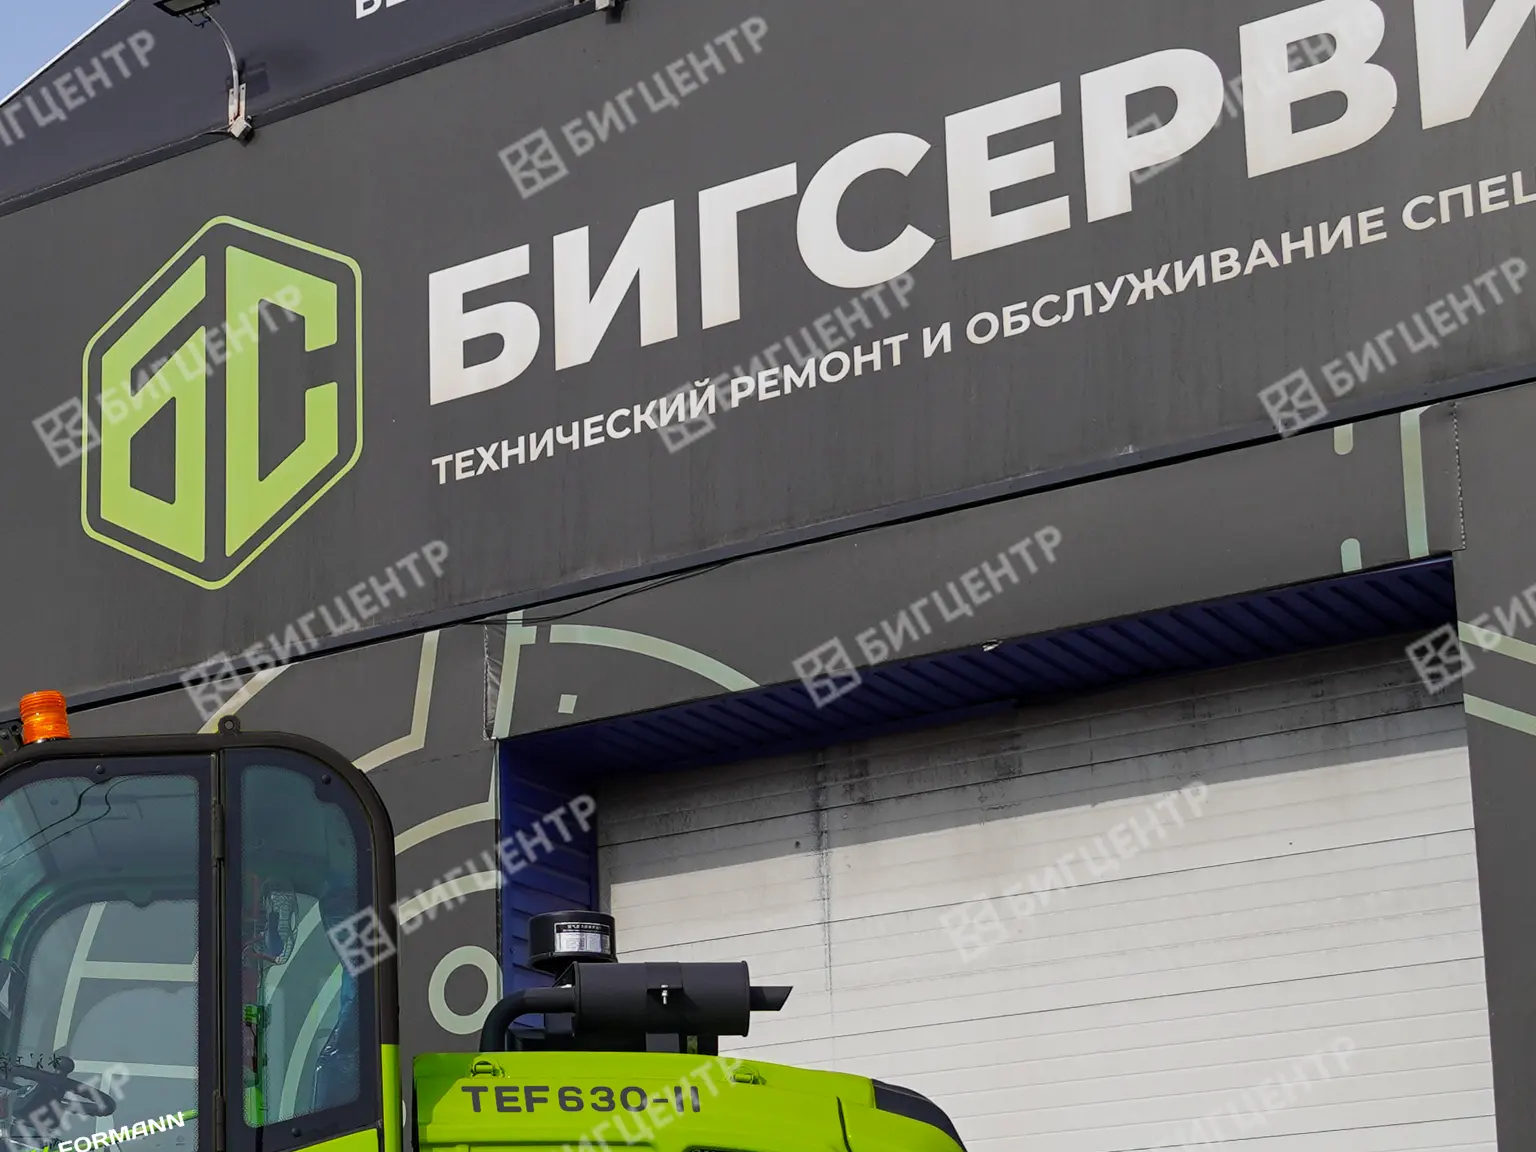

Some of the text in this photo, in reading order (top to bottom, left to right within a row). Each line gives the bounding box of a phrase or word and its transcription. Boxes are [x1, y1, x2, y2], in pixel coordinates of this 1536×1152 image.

[431, 378, 716, 485] ТЕХНИЧЕСКИЙ
[730, 332, 909, 408] РЕМОНТ
[922, 321, 953, 359] И
[965, 206, 1387, 345] ОБСЛУЖИВАНИЕ
